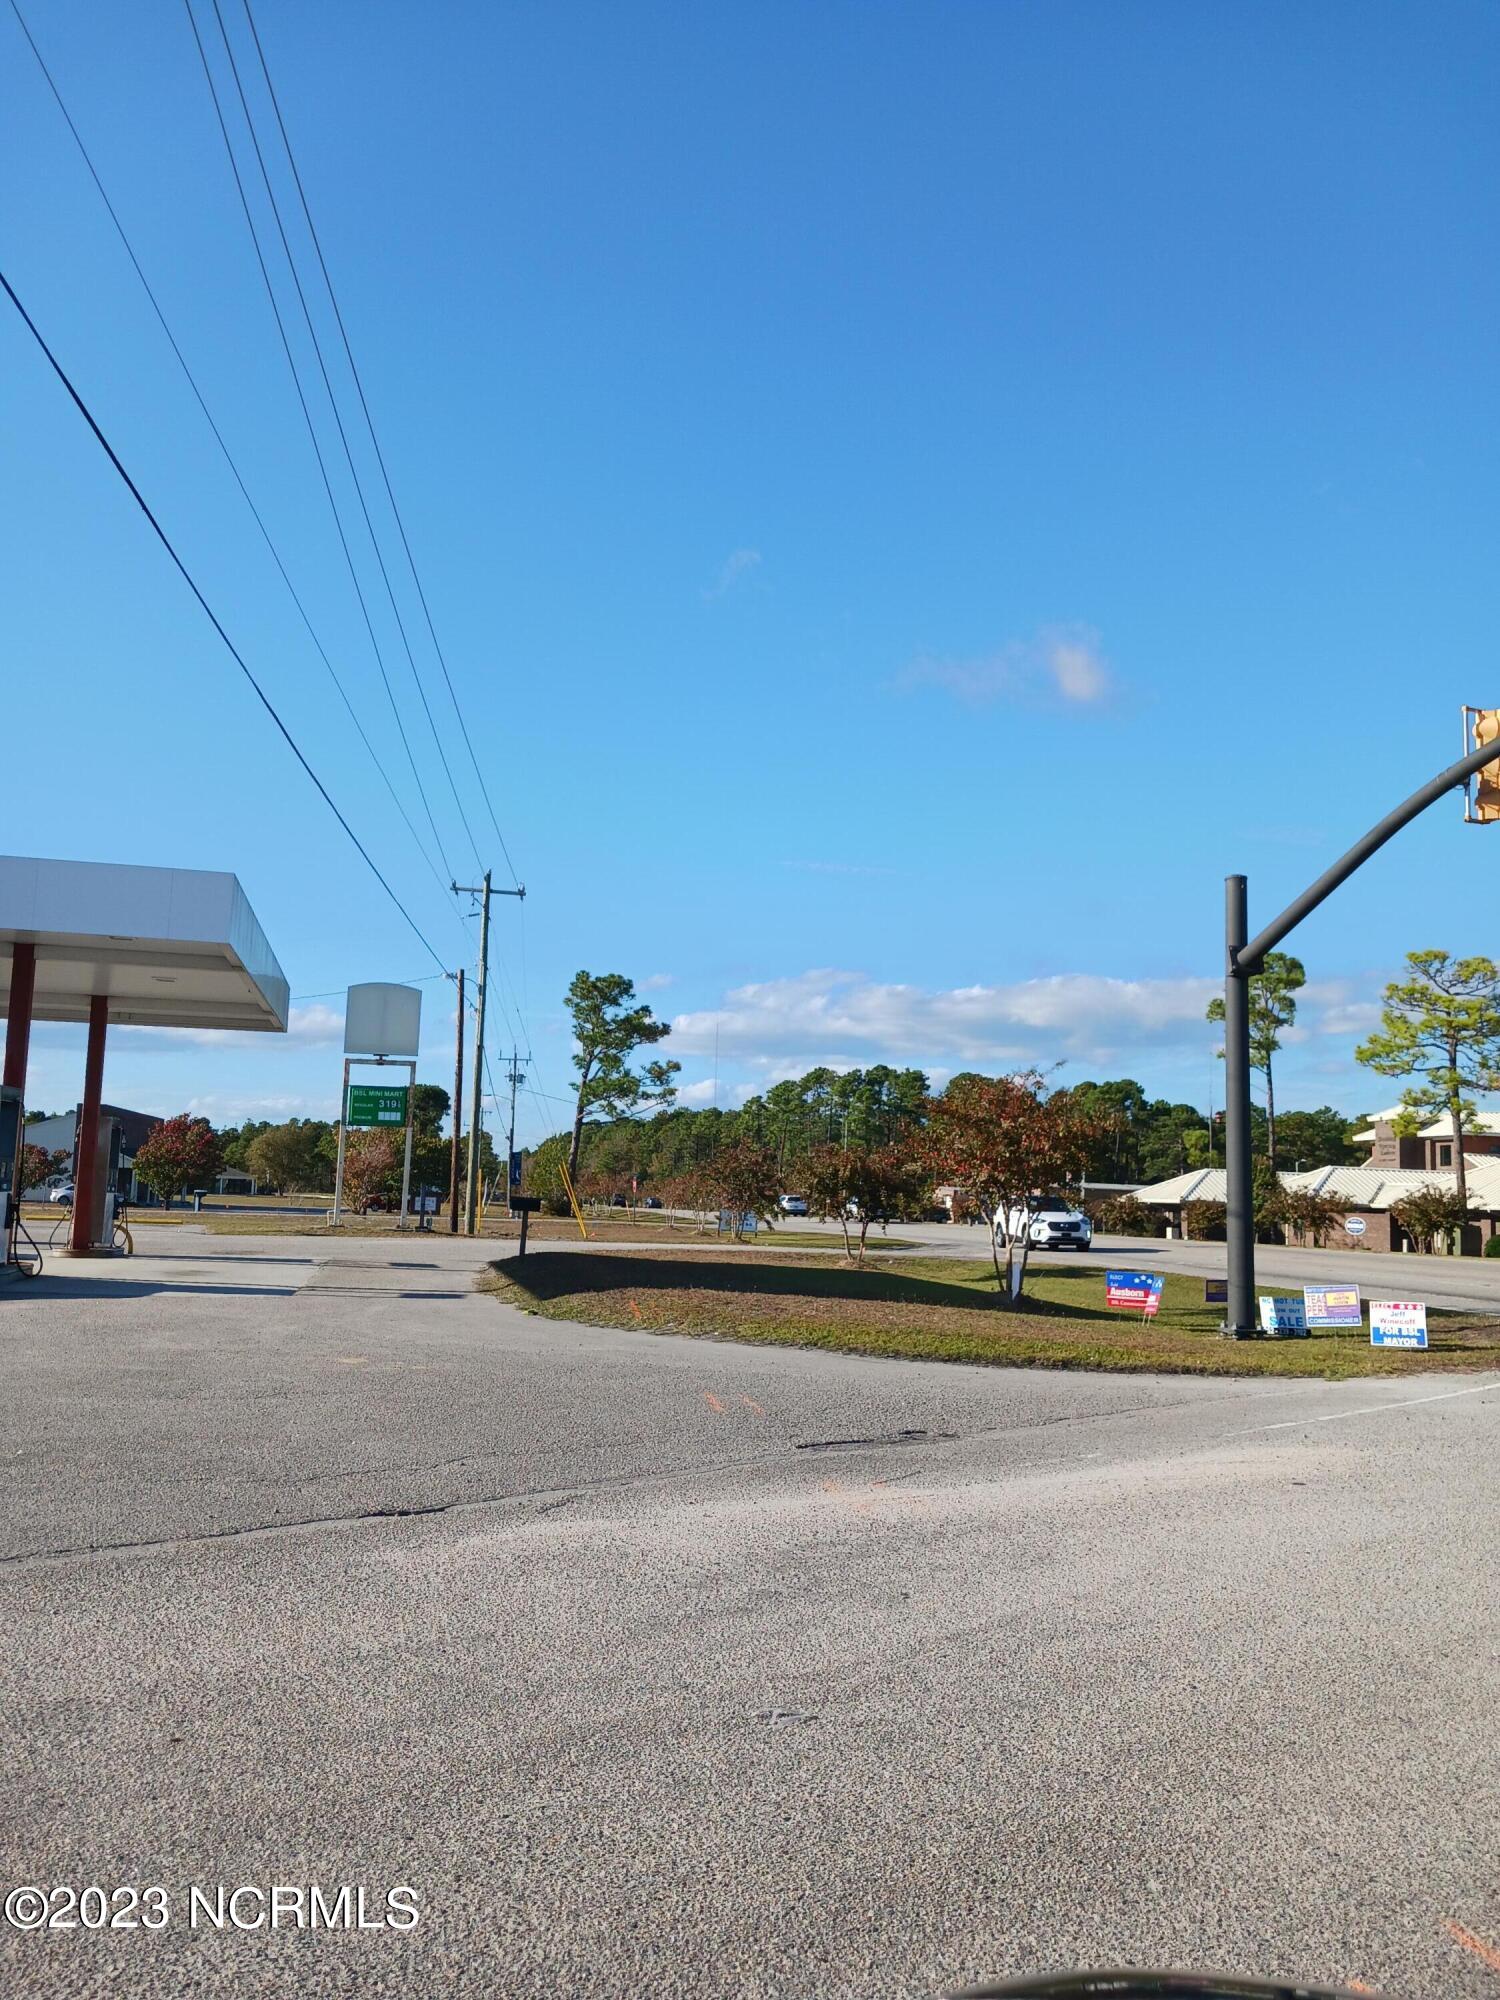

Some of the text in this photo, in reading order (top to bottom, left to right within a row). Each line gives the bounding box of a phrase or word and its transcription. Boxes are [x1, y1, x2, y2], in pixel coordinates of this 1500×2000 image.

[1110, 1287, 1145, 1298] Ausborn
[1269, 1316, 1304, 1327] SALE
[1379, 1326, 1399, 1335] FOR
[1383, 1335, 1419, 1346] MAYOR
